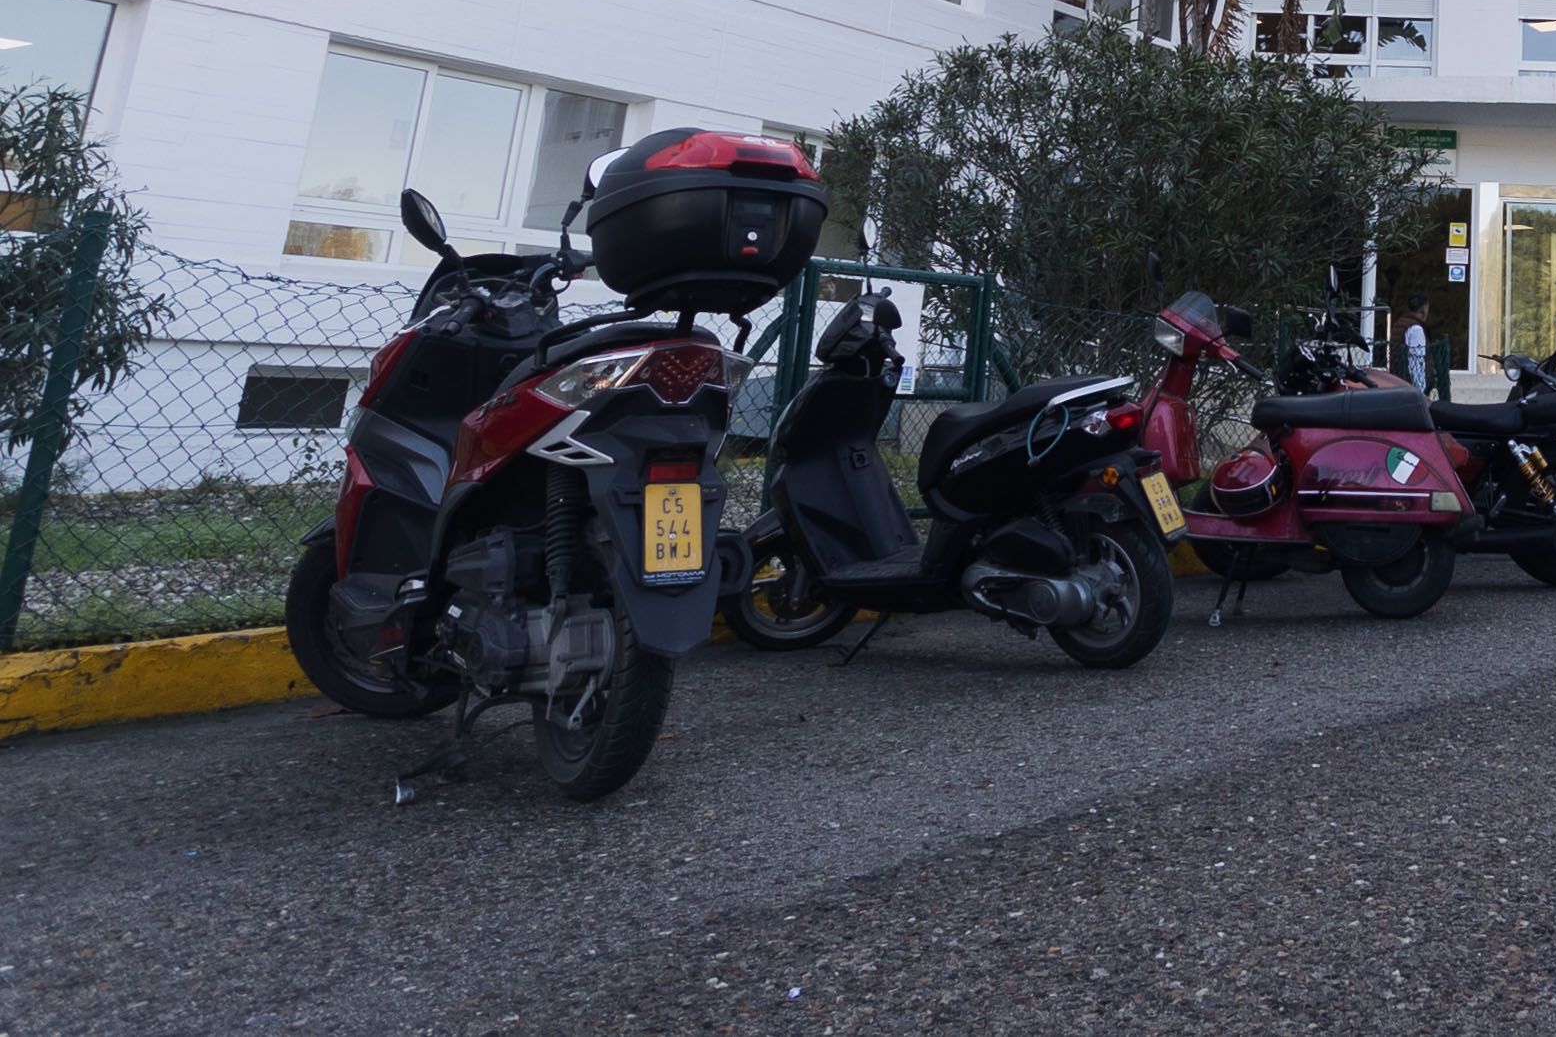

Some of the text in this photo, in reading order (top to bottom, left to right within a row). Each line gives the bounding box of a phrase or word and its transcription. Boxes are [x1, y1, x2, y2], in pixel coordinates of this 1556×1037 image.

[662, 498, 684, 514] C5
[656, 520, 690, 537] 544
[656, 542, 691, 560] BWJ
